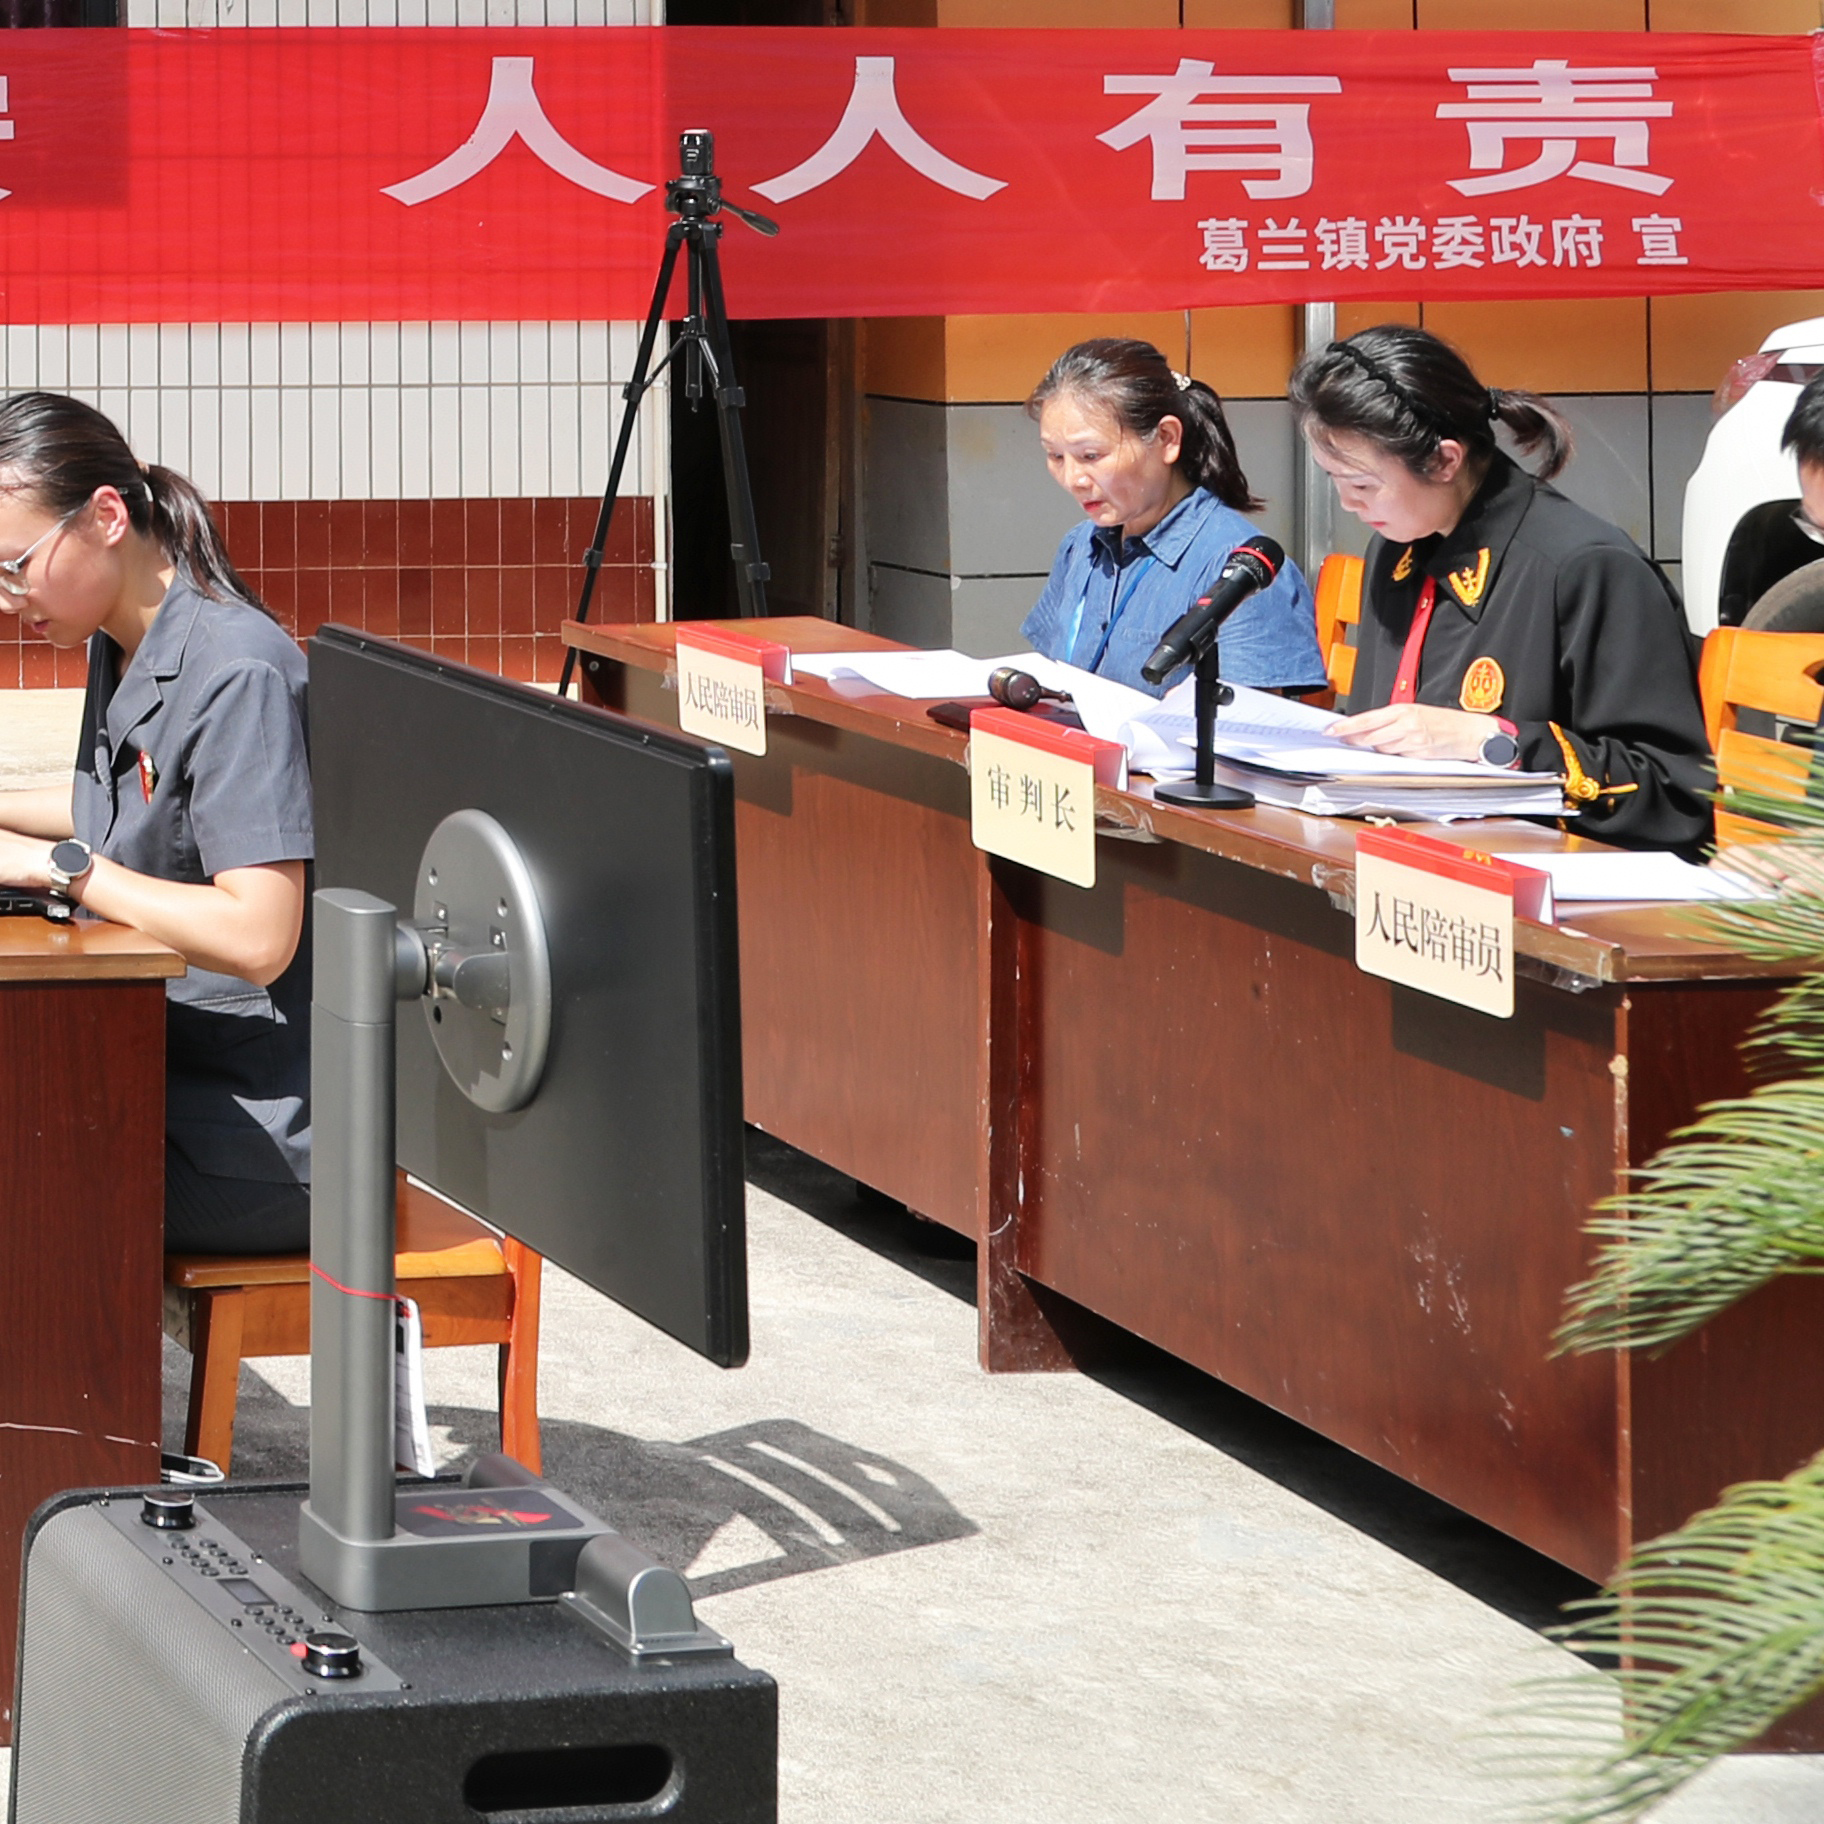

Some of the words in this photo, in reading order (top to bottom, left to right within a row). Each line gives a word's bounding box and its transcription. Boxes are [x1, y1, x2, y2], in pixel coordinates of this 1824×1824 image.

[380, 56, 1675, 205] 人人有责
[1197, 215, 1606, 271] 葛兰镇党委政府
[1633, 214, 1689, 269] 宣
[684, 670, 759, 732] 人民陪审员
[987, 762, 1076, 833] 审判长
[1365, 890, 1503, 984] 人民陪审员
